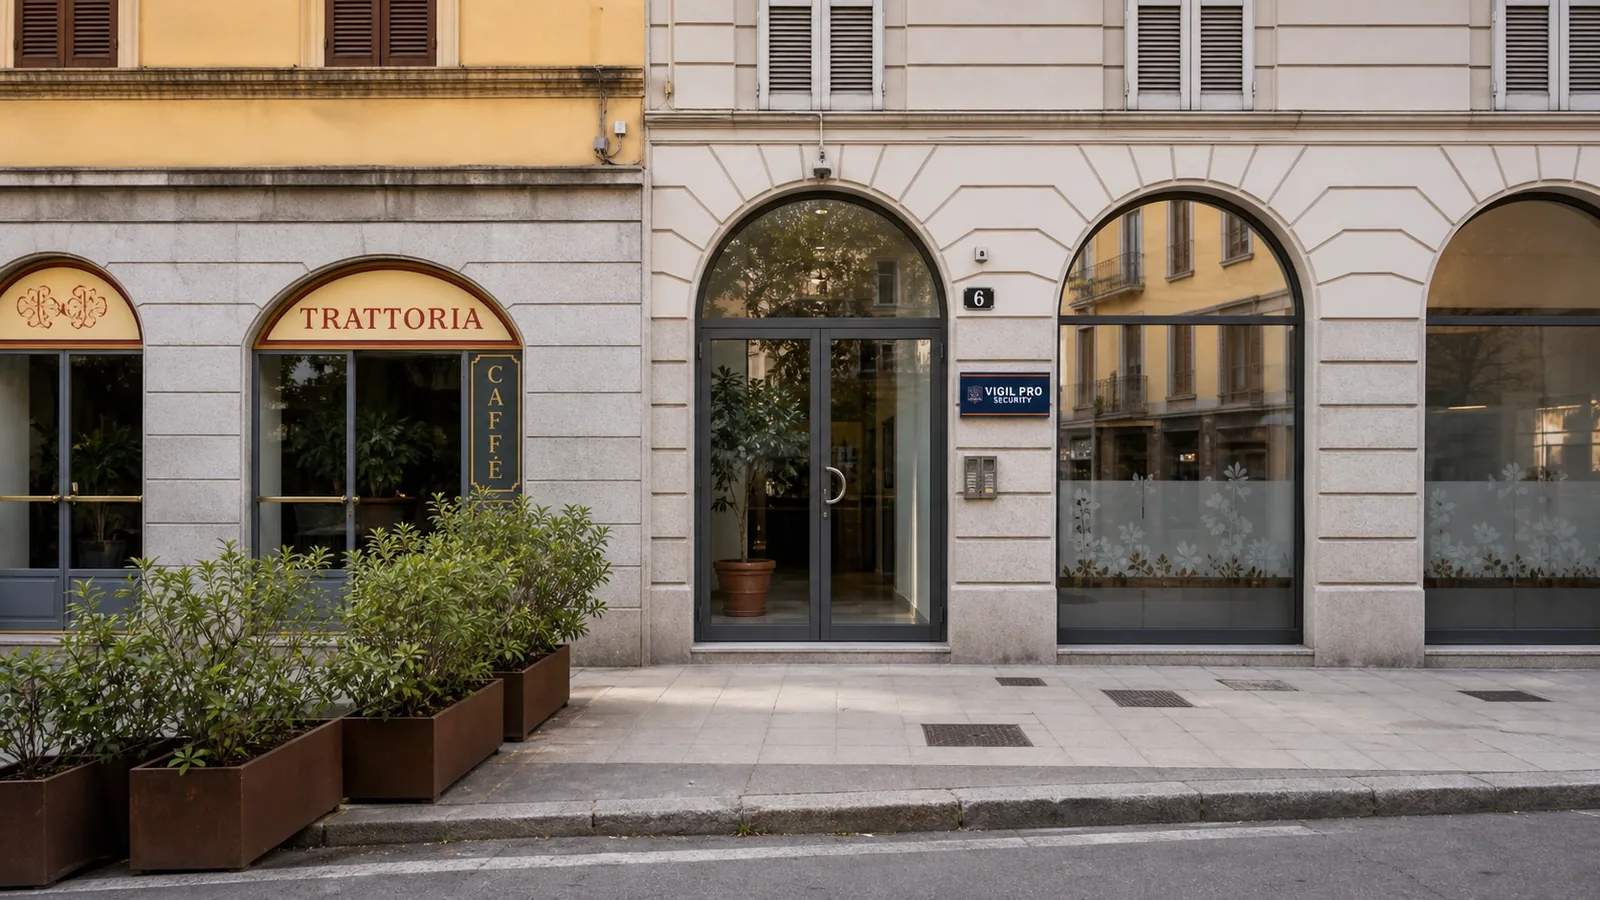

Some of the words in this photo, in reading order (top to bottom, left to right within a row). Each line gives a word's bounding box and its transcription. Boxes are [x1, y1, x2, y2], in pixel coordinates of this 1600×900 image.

[973, 290, 985, 307] 6
[300, 307, 484, 330] TRATTORIA
[984, 386, 1016, 396] VIGIL
[1019, 386, 1043, 396] PRO
[993, 396, 1032, 404] SECURITY
